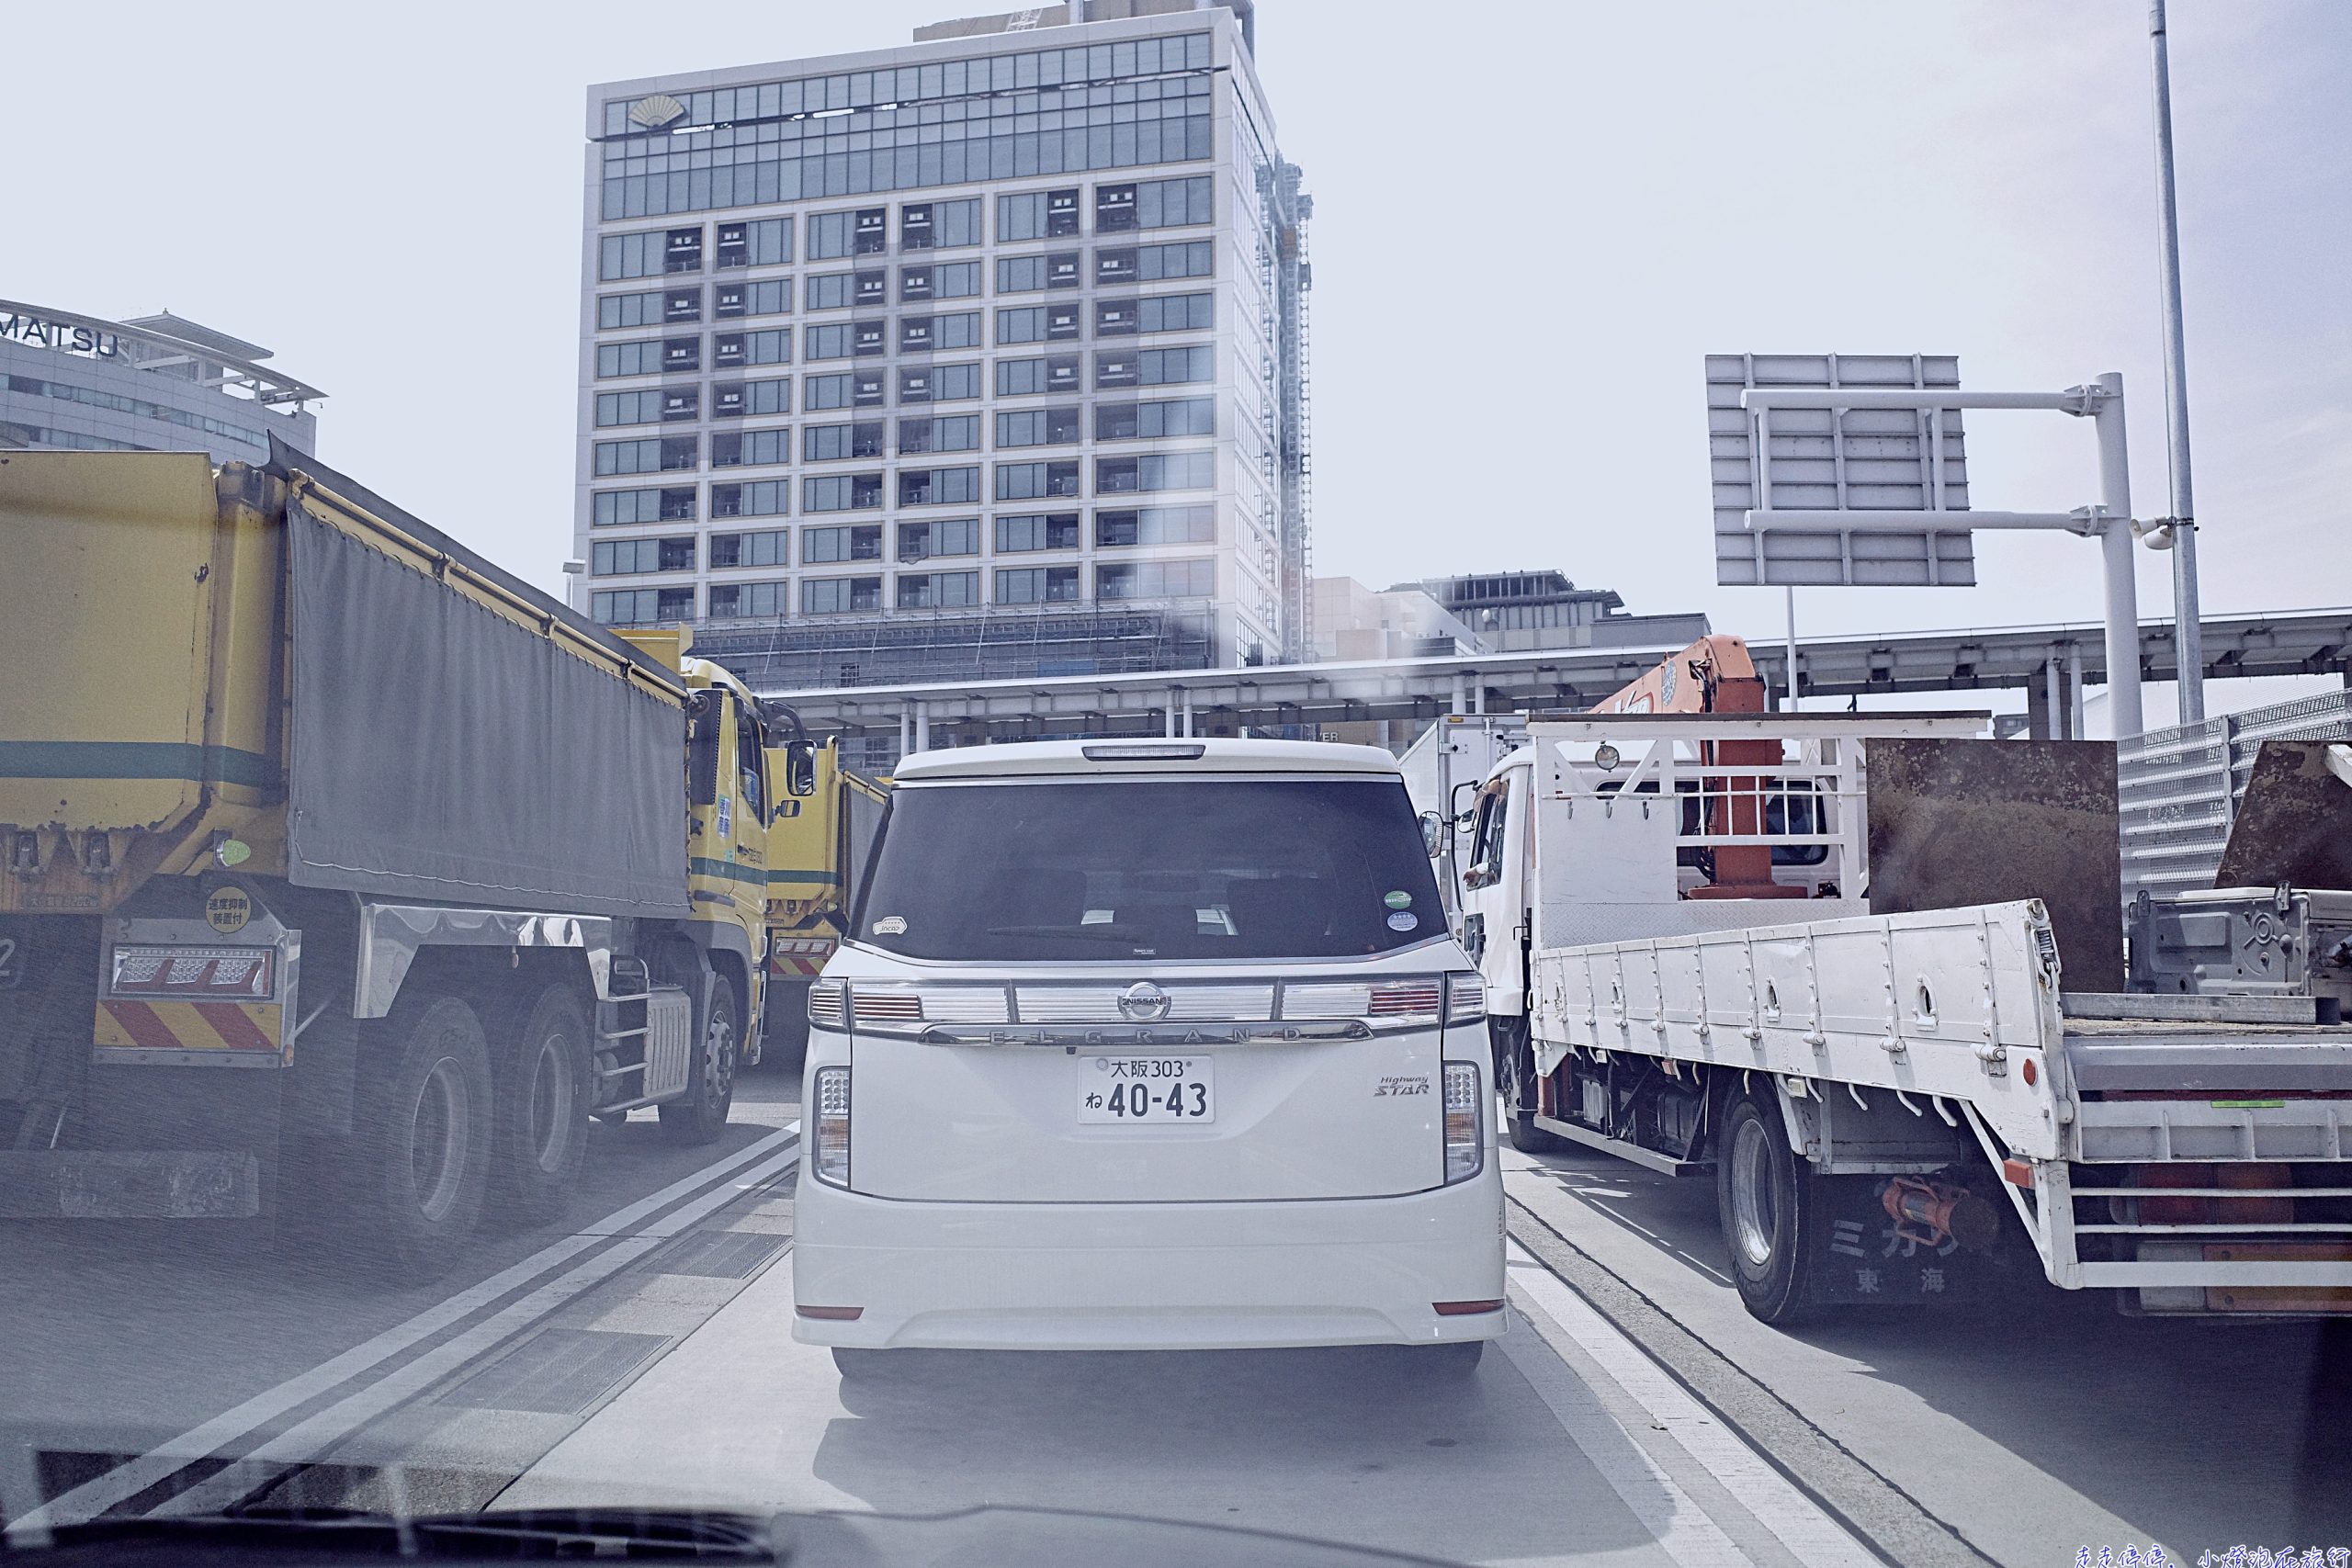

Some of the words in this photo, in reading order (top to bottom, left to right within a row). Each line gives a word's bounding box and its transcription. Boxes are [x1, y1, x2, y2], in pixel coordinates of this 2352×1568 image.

[209, 898, 248, 910] 速度抑制
[212, 912, 243, 925] 装置付
[989, 1027, 1301, 1044] ELGRAND
[1380, 1076, 1429, 1085] Highway
[1374, 1084, 1430, 1098] STAR
[1085, 1091, 1102, 1109] ね
[1108, 1083, 1207, 1117] 40-43
